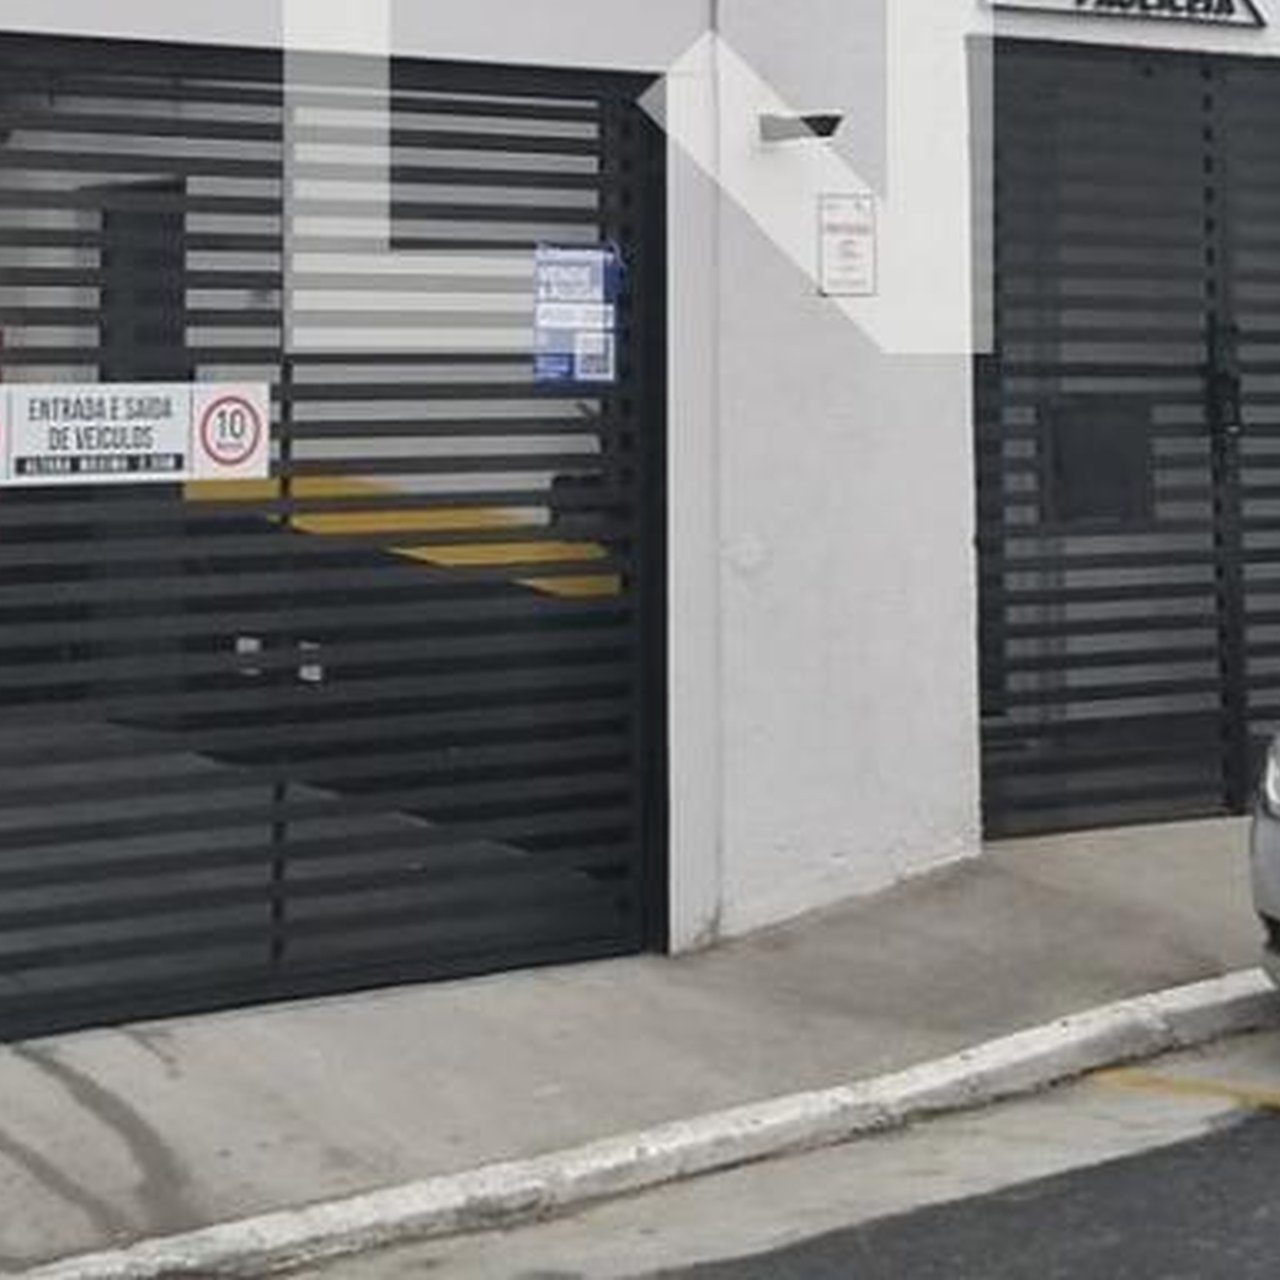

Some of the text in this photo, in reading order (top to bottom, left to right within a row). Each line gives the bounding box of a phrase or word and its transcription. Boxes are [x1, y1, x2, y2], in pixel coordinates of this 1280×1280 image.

[28, 397, 105, 421] ENTRADA
[109, 397, 120, 420] E
[216, 408, 246, 439] 10
[48, 426, 70, 451] DE
